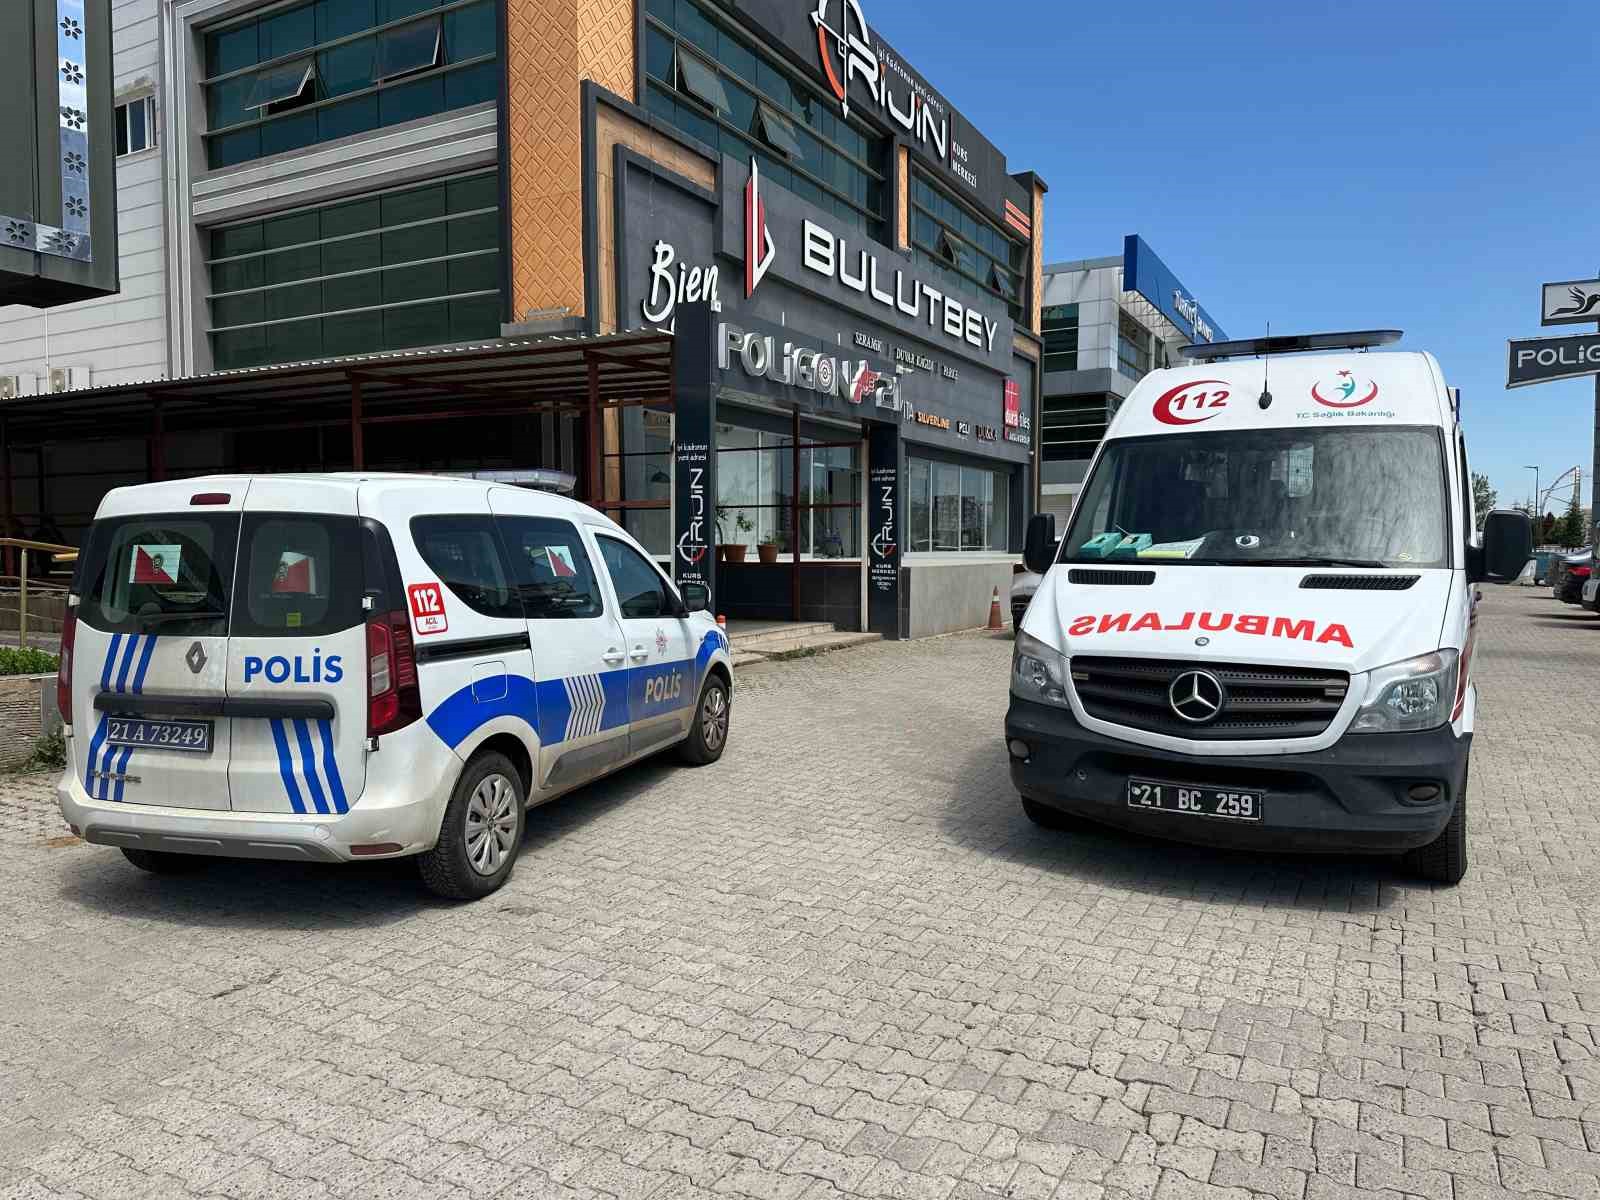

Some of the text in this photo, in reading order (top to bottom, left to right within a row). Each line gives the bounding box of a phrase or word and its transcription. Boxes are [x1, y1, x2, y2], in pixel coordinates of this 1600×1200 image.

[952, 140, 968, 162] KURS
[643, 240, 719, 322] Bien
[804, 219, 997, 351] BULUTBEY
[1174, 390, 1230, 410] 112
[413, 588, 441, 613] 112
[244, 647, 344, 684] POLİS
[644, 667, 682, 704] POLİS
[110, 722, 205, 745] 21 A 73249
[1140, 784, 1253, 816] 21 BC 259
